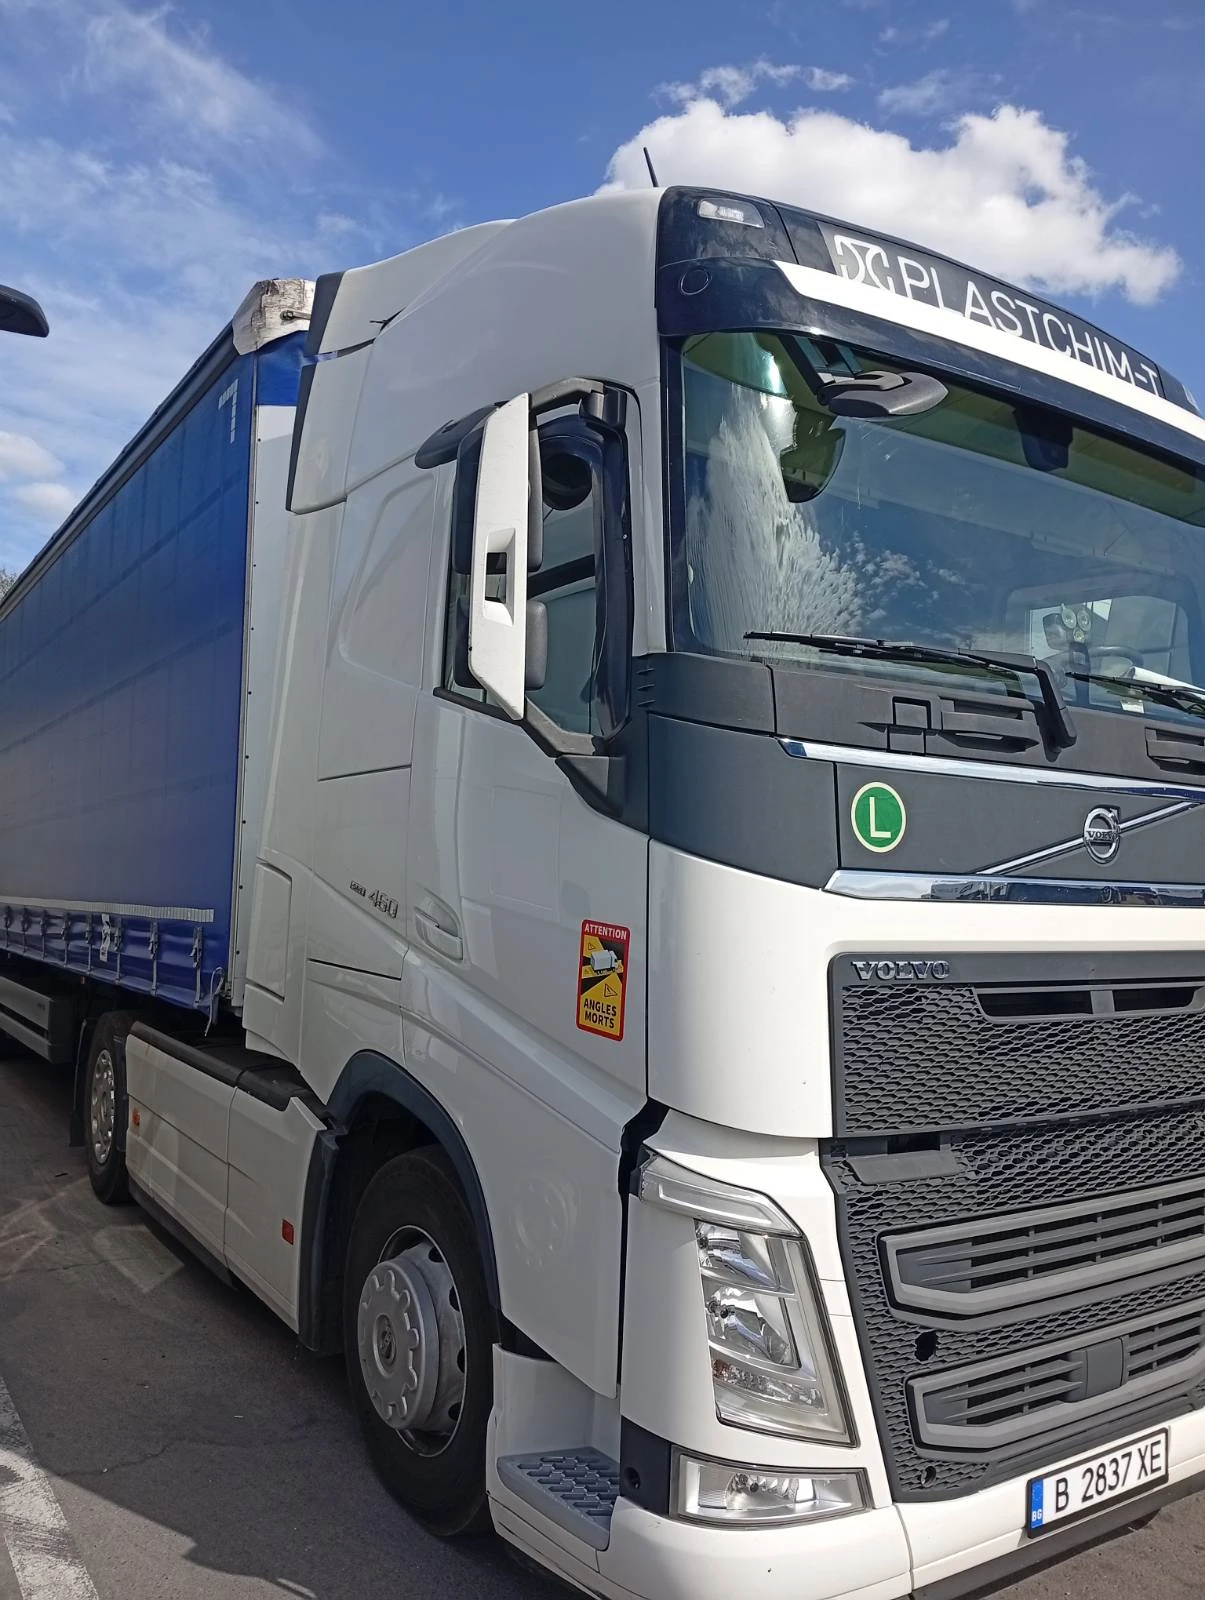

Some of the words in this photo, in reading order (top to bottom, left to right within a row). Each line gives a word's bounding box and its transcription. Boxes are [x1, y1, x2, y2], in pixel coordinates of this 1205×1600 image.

[898, 255, 1159, 398] PLASTCHIM-T
[869, 796, 892, 838] L
[584, 923, 627, 940] ATTENTION
[851, 960, 950, 980] VOLVO
[583, 998, 617, 1016] ANGLES
[584, 1011, 615, 1029] MORTS
[1055, 1477, 1069, 1513] B
[1081, 1451, 1132, 1502] 2837
[1138, 1440, 1162, 1480] XE
[1031, 1508, 1043, 1522] BG
